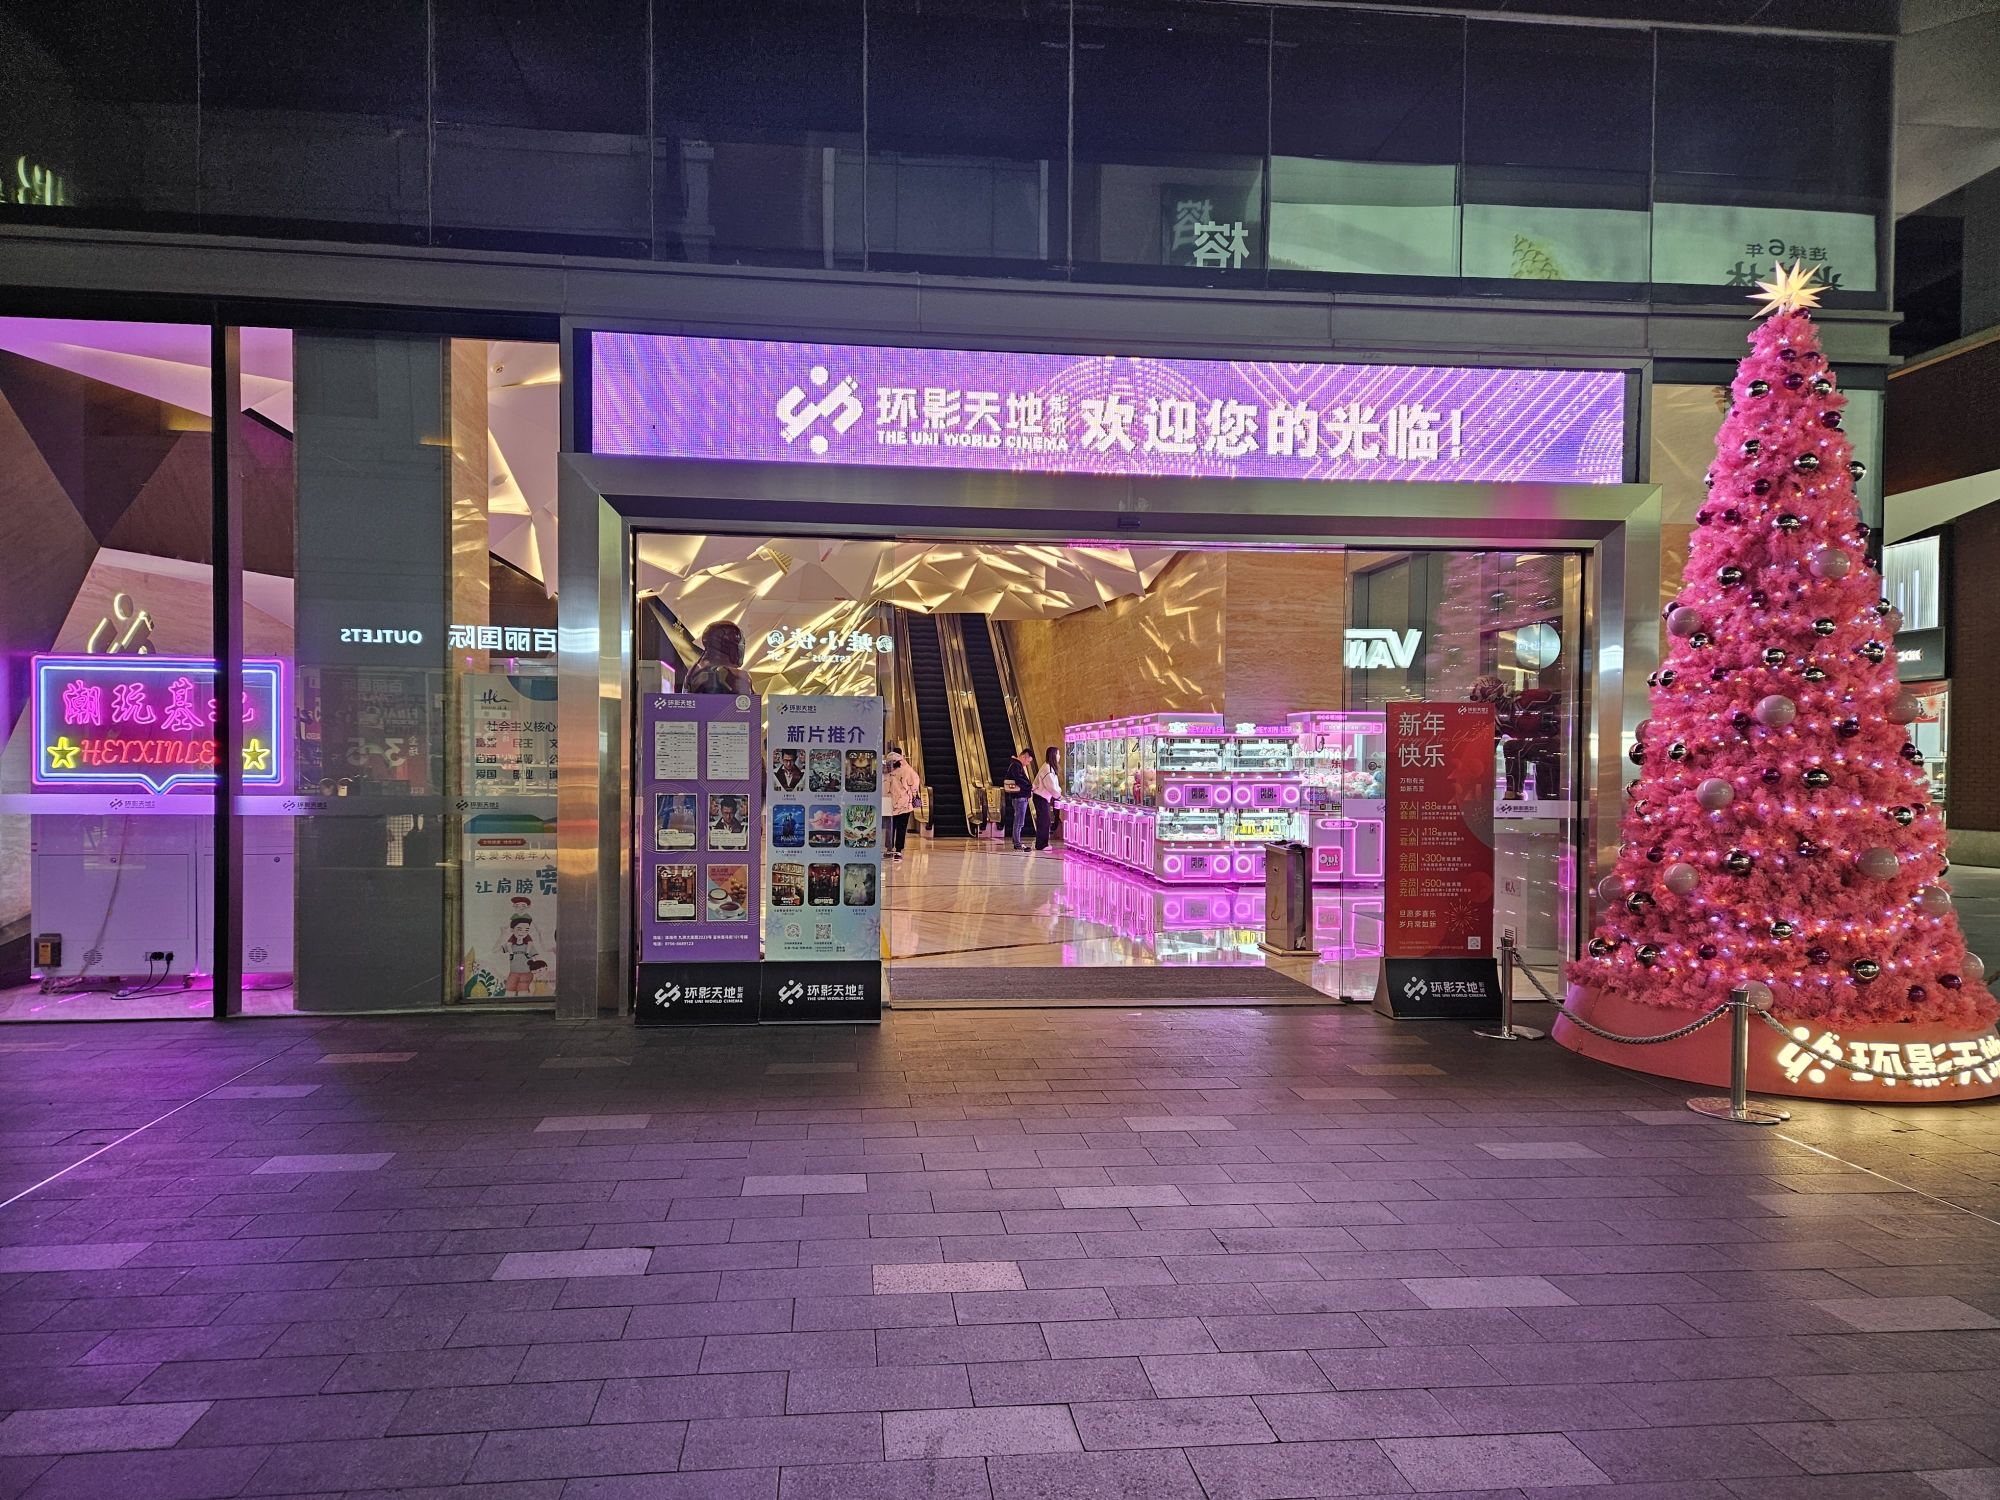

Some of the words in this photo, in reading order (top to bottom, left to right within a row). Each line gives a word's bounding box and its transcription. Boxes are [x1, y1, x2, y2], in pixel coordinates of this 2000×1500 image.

[877, 387, 1045, 433] 环影天地
[877, 431, 907, 444] THE
[911, 432, 939, 445] UNI
[944, 432, 1001, 448] WORLD
[1006, 435, 1069, 450] CINEMA
[487, 721, 557, 733] 社会主义核心
[1399, 711, 1445, 737] 新年
[787, 725, 865, 744] 新片推介
[1399, 744, 1445, 768] 快乐
[1400, 828, 1417, 836] 三人
[684, 986, 736, 999] 环影天地
[807, 984, 857, 996] 环影天地
[1430, 981, 1479, 993] 环影天地
